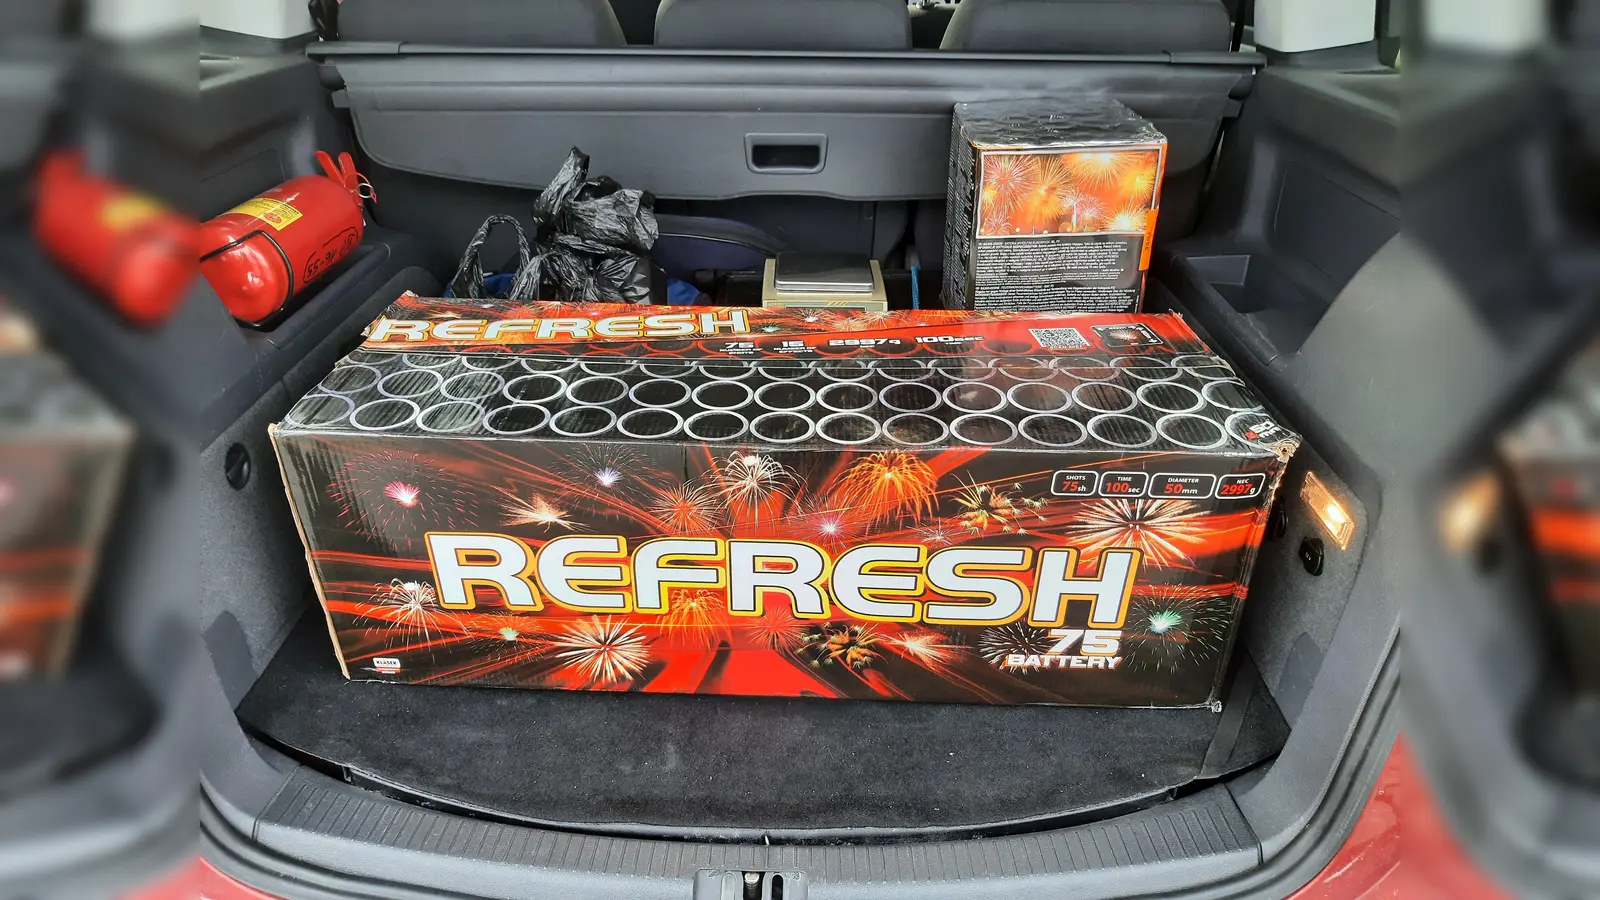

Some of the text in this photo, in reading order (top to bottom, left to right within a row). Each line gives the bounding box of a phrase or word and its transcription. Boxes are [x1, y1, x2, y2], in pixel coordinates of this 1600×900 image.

[368, 308, 750, 342] REFRESH
[1062, 481, 1086, 492] 75sh
[1105, 482, 1140, 493] 100sec
[1164, 483, 1198, 495] 50mm
[1221, 483, 1256, 495] 2997g
[424, 531, 1141, 630] REFRESH
[1044, 629, 1122, 656] 75
[1003, 654, 1123, 669] BATTERY
